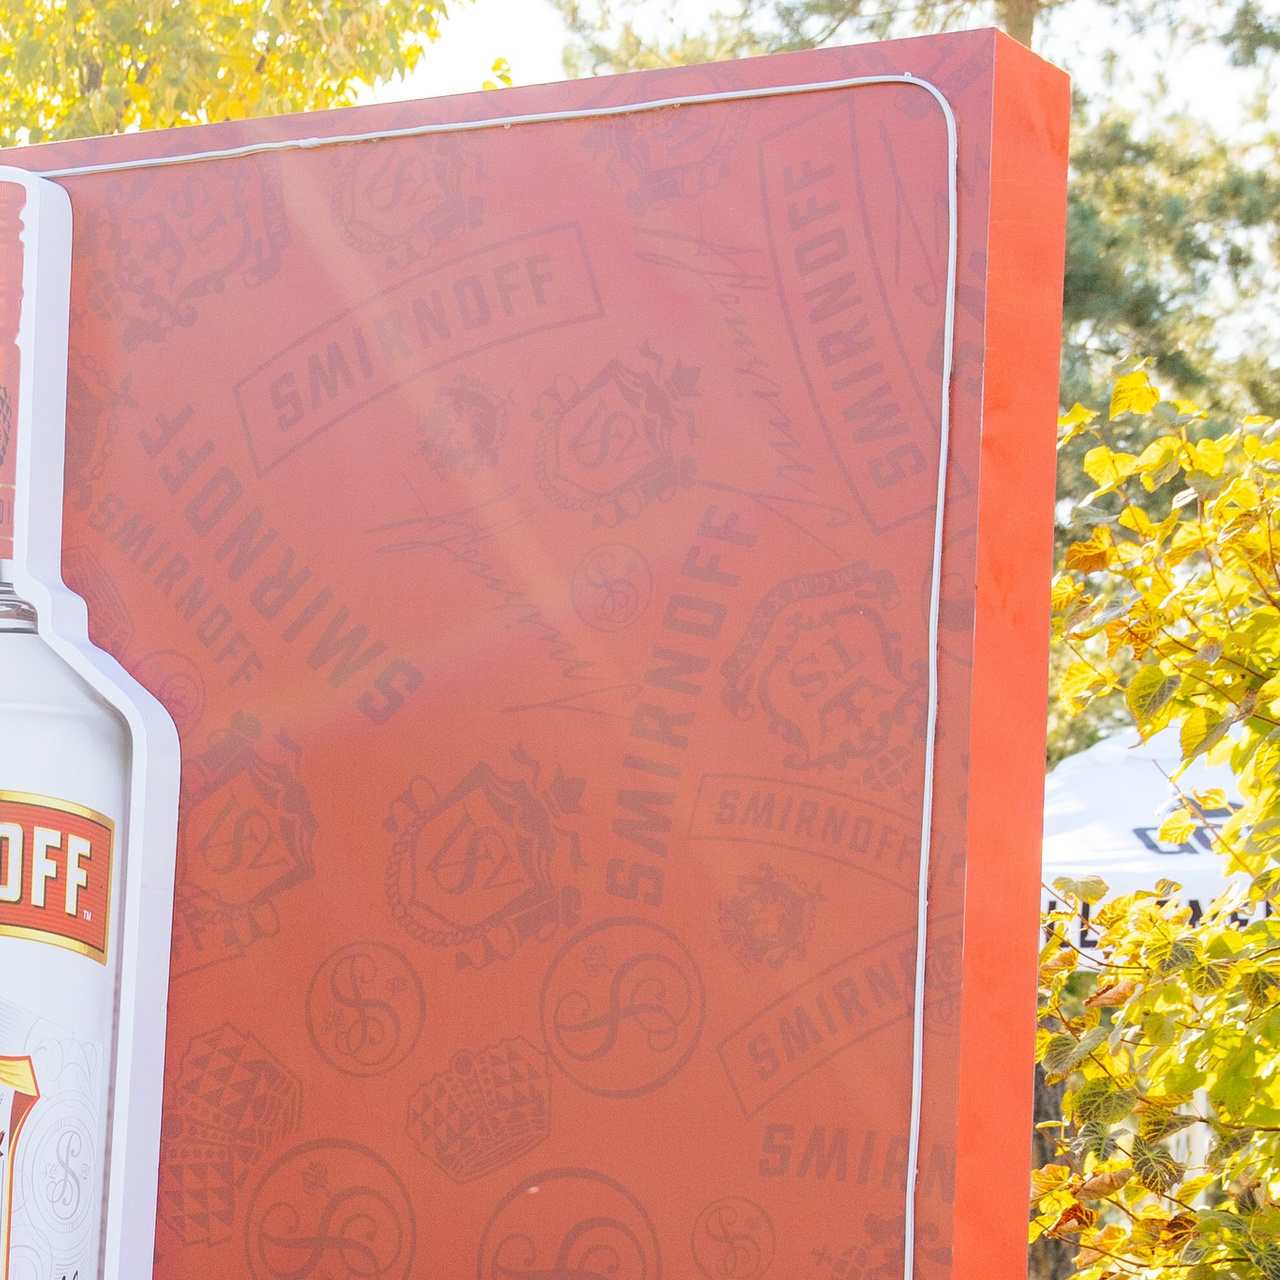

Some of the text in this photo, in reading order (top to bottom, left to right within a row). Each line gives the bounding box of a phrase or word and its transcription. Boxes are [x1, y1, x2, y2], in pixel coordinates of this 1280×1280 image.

[269, 251, 559, 431] SMIRNOFF
[783, 157, 927, 490] SMIRNOFF
[86, 492, 266, 688] SMIRNOFF
[138, 403, 426, 726] SMIRNOFF
[604, 503, 758, 907] SMIRNOFF
[714, 788, 920, 871] SMIRNOFF
